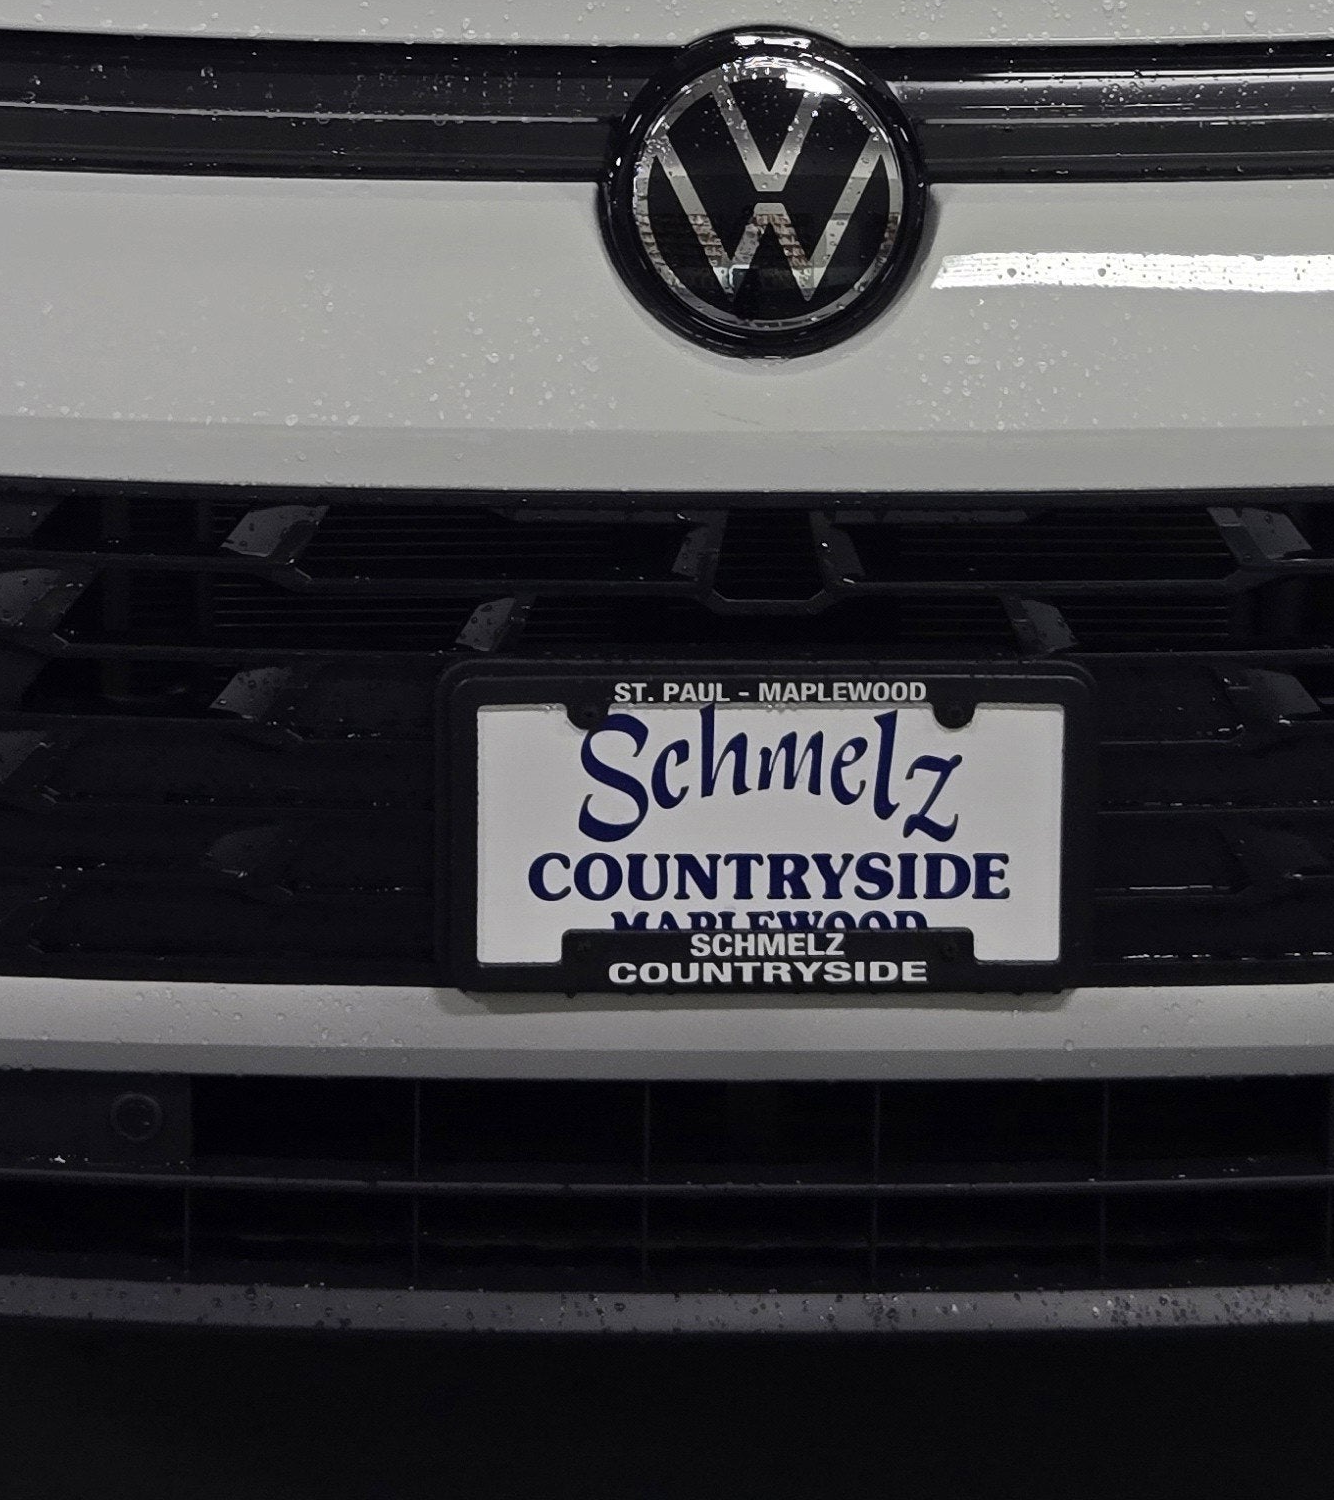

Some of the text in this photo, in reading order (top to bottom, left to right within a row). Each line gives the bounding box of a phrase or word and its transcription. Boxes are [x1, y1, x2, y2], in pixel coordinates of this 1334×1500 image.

[639, 65, 897, 315] VW
[614, 682, 654, 702] ST.
[663, 682, 730, 702] PAUL
[758, 682, 927, 702] MAPLEWOOD
[578, 704, 963, 842] Schmelz
[528, 853, 1011, 901] COUNTRYSIDE
[690, 933, 845, 957] SCHMELZ
[608, 961, 928, 984] COUNTRYSIDE
